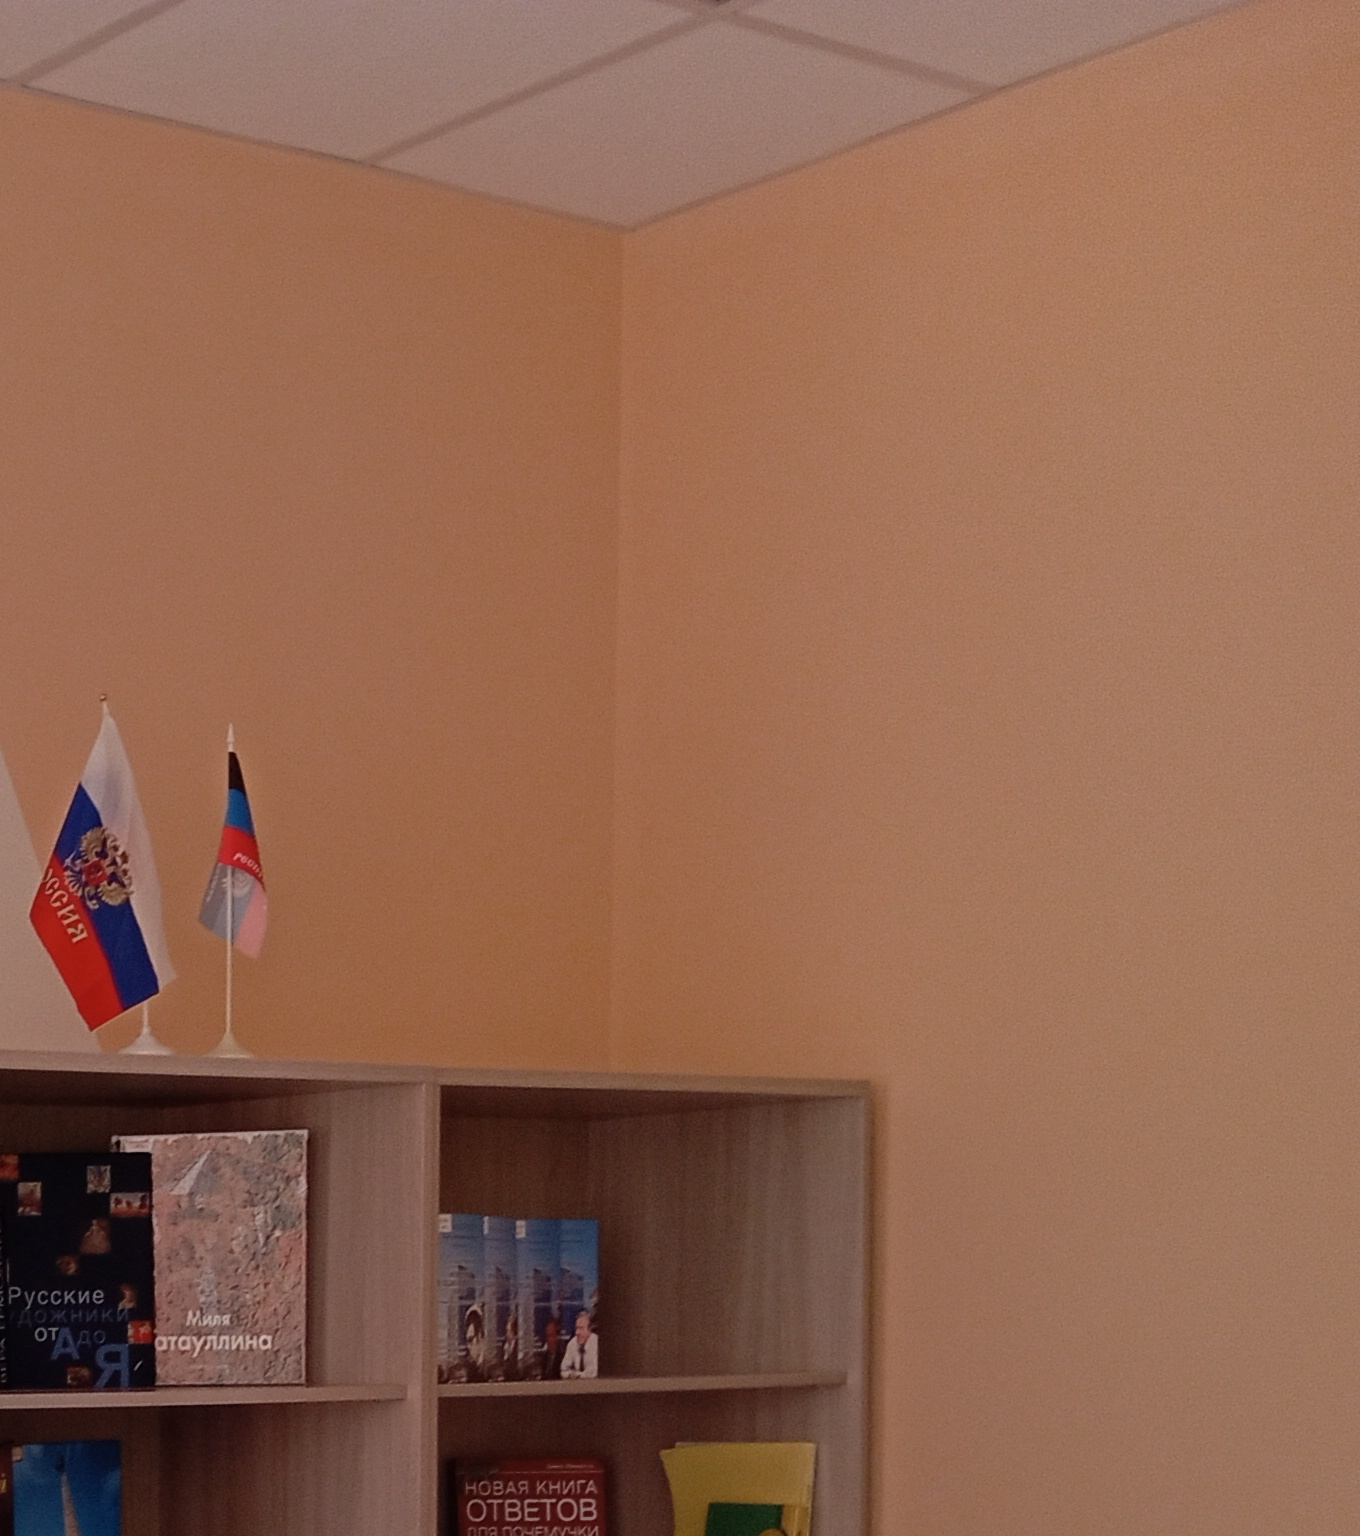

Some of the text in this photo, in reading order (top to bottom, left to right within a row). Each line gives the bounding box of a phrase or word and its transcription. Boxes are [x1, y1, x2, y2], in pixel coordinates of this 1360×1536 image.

[43, 868, 88, 943] ССИЯ
[8, 1286, 105, 1310] Русские
[154, 1333, 274, 1359] атауллина
[94, 1342, 131, 1390] Я
[465, 1478, 598, 1496] НОВАЯ КНИГА
[466, 1498, 599, 1523] ОТВЕТОВ
